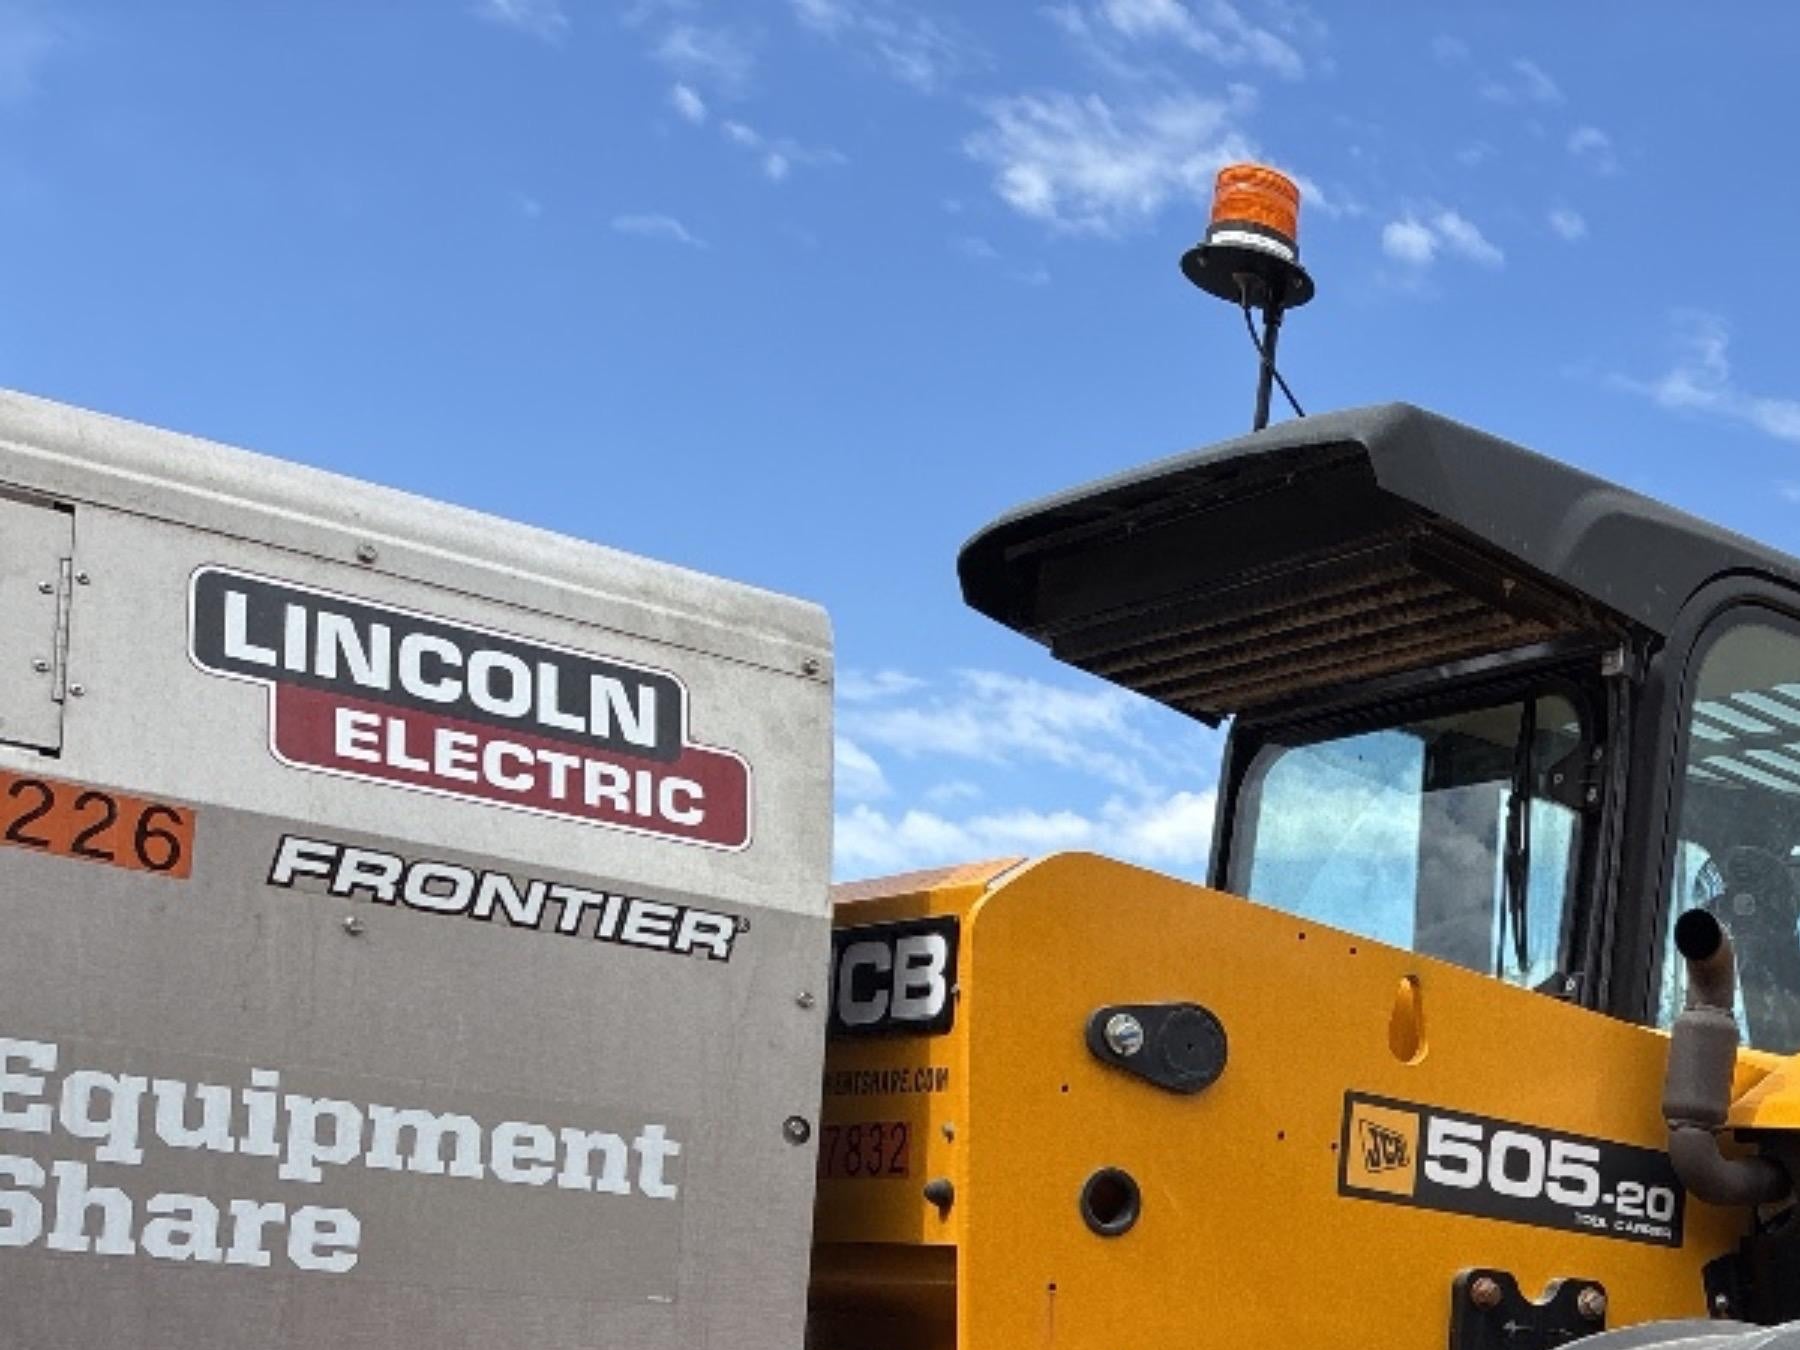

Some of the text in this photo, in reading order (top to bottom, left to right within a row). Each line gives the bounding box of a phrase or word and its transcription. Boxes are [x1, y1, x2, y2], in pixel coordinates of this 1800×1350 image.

[222, 588, 660, 750] LINCOLN
[334, 706, 706, 827] ELECTRIC
[831, 933, 949, 1027] CB
[0, 1038, 683, 1200] Equipment
